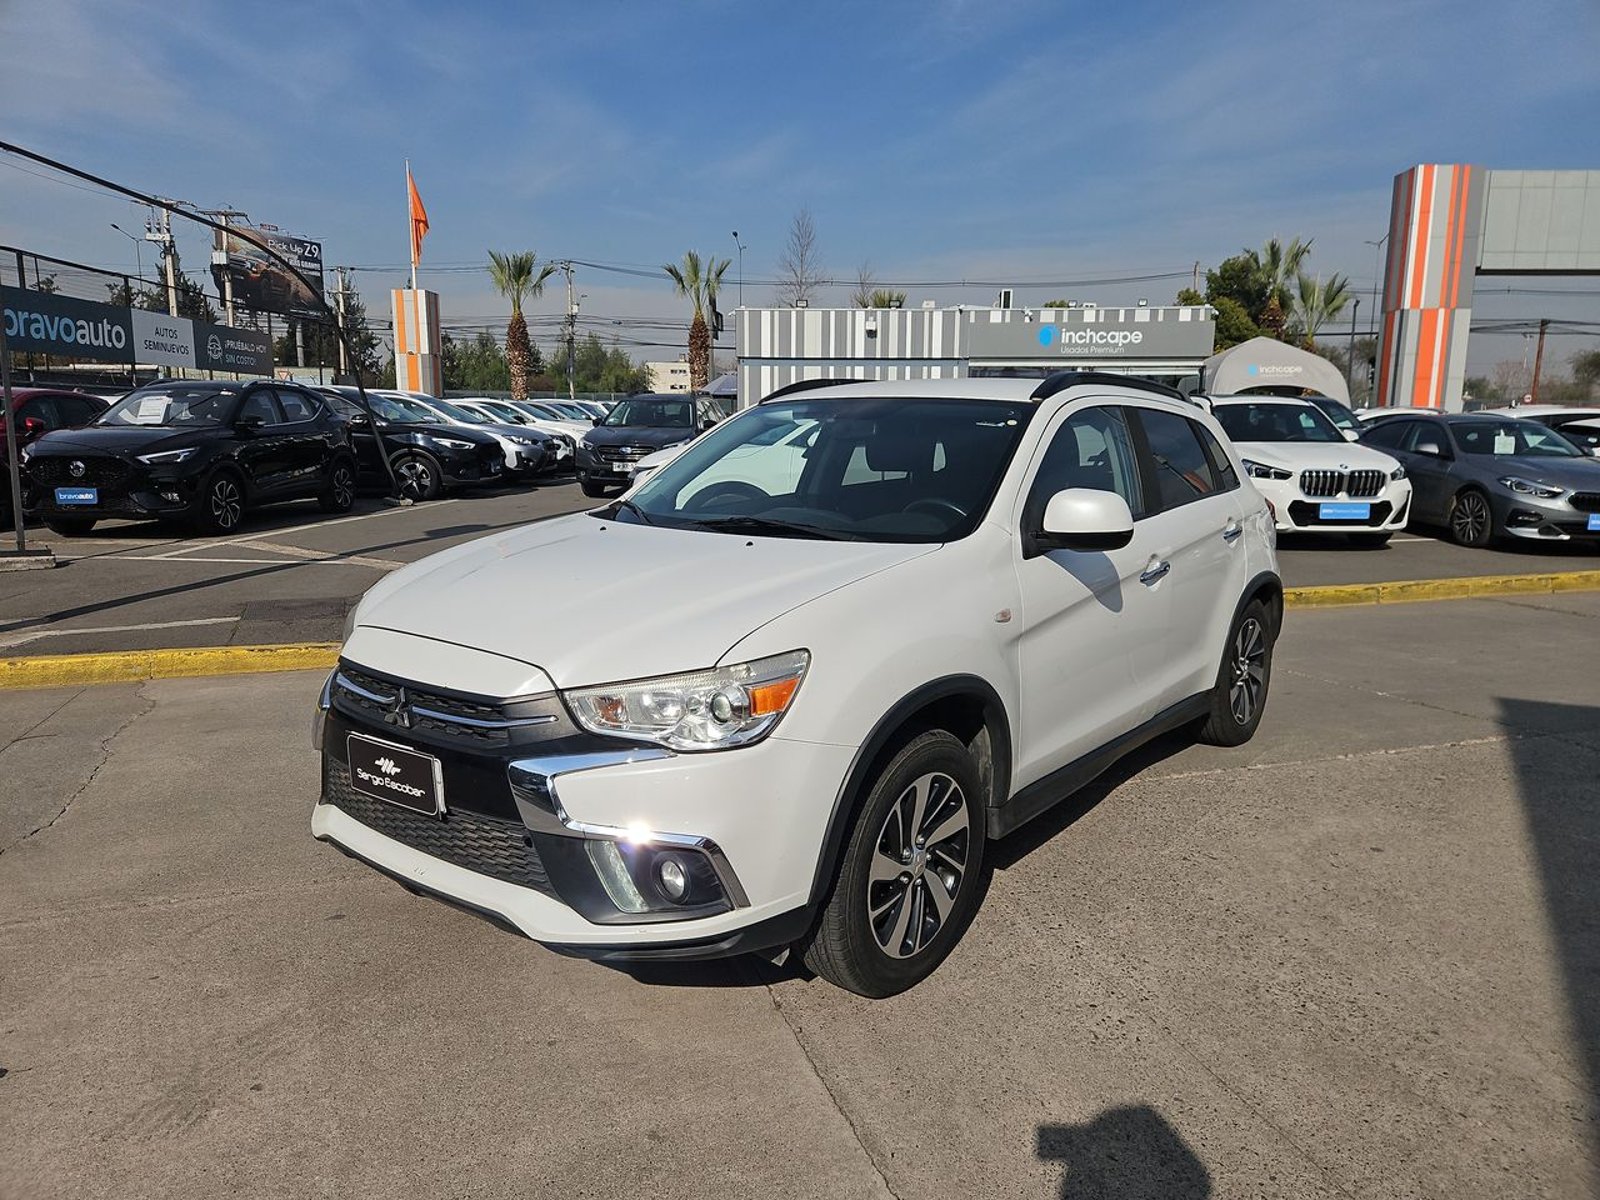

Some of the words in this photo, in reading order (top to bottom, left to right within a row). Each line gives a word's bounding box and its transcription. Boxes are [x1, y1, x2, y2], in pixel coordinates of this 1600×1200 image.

[303, 243, 319, 258] Z9
[154, 326, 178, 340] AUTOS
[1061, 328, 1143, 346] inchcape
[143, 339, 190, 356] SEMINUEVOS
[1060, 345, 1089, 354] Usados
[1090, 345, 1125, 354] Premium
[225, 353, 235, 363] SIN
[1259, 364, 1302, 374] inchcape
[384, 776, 426, 797] Escobar
